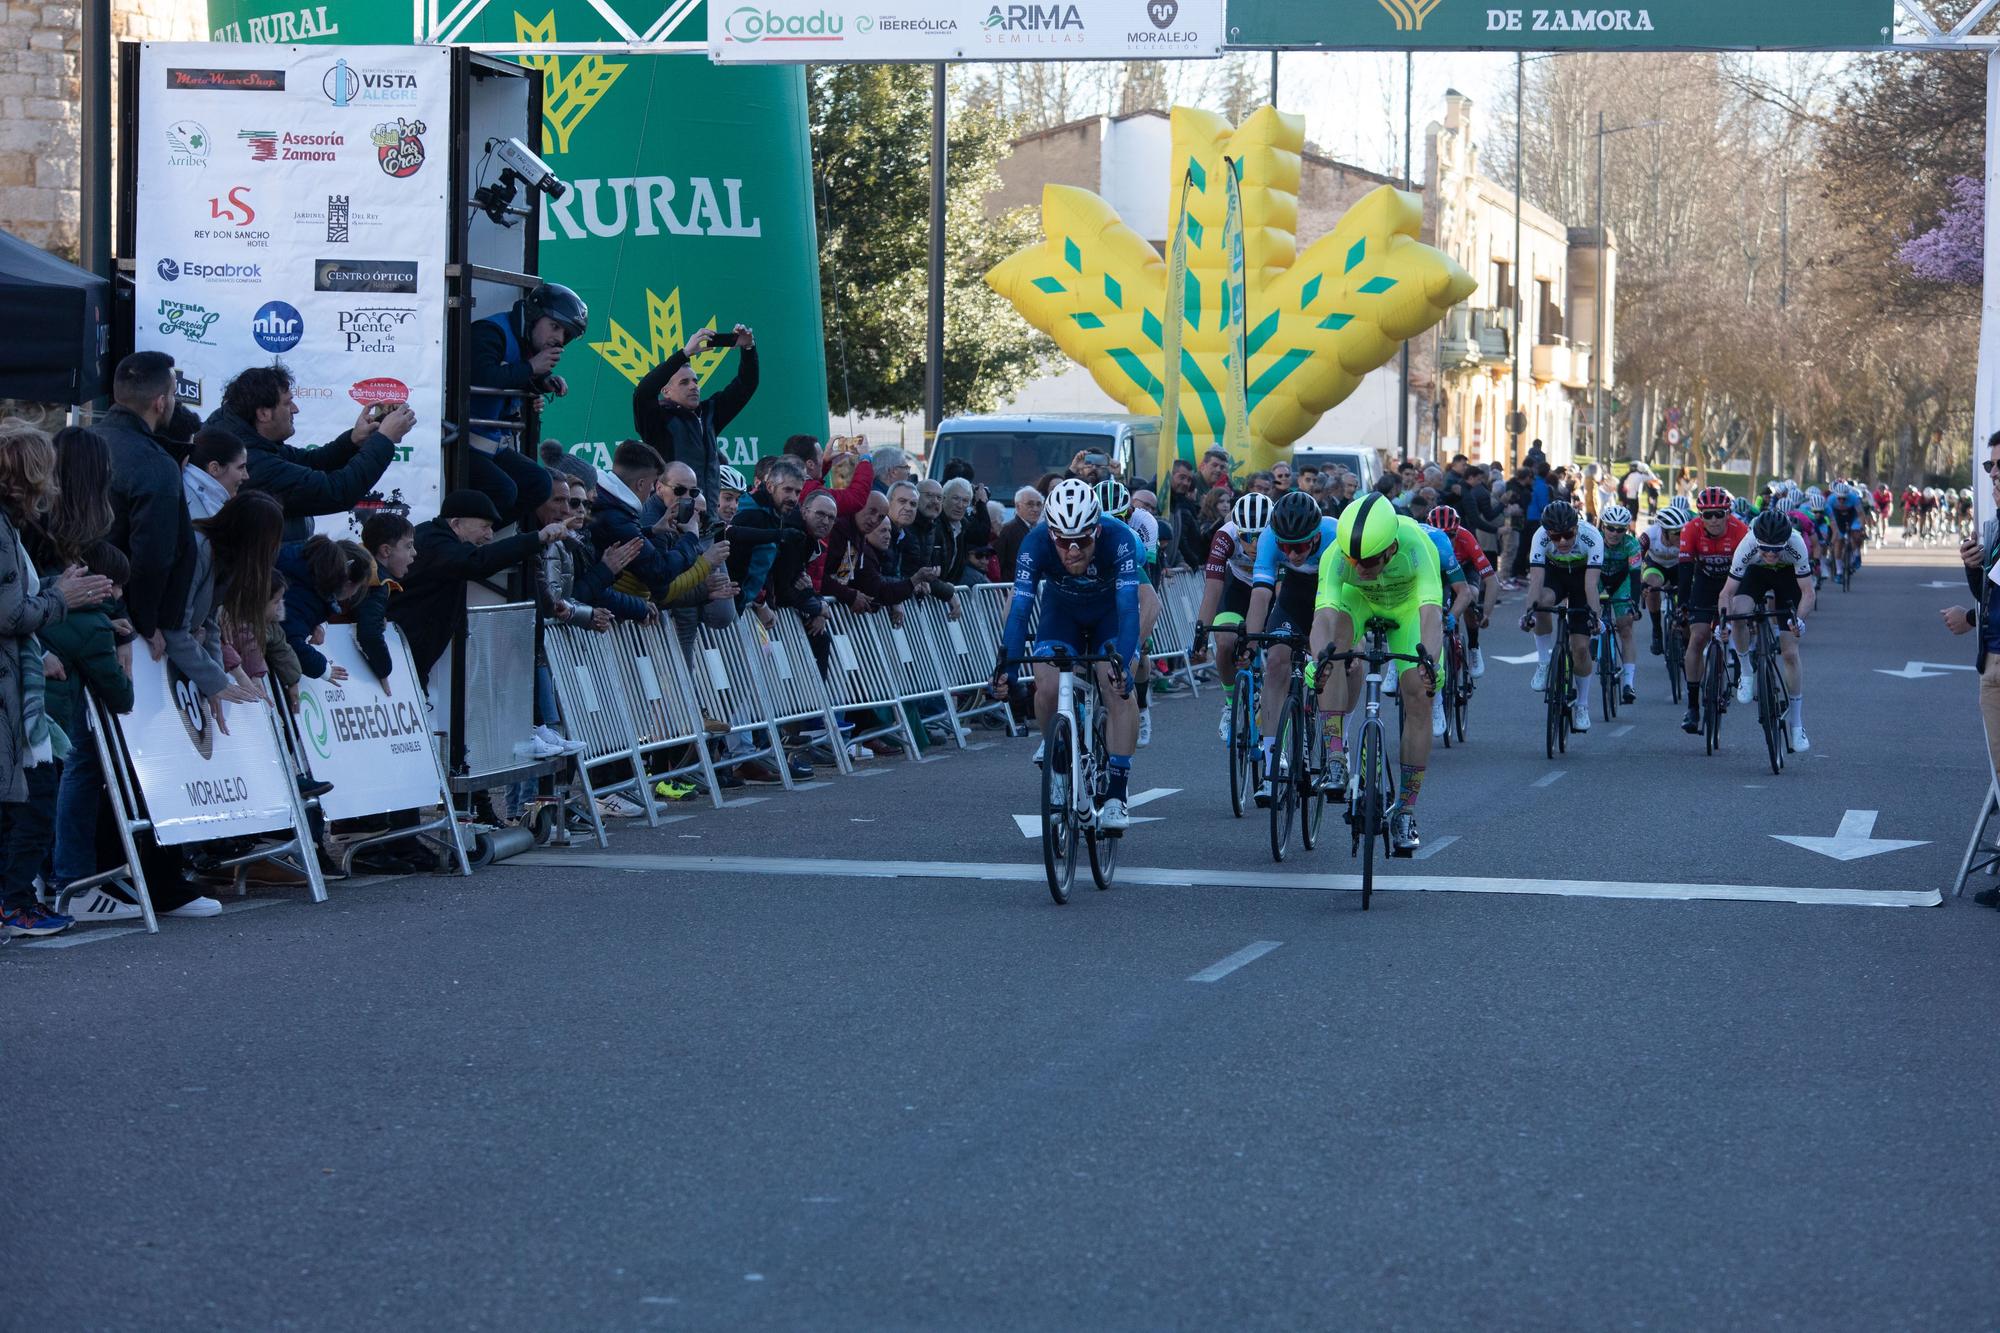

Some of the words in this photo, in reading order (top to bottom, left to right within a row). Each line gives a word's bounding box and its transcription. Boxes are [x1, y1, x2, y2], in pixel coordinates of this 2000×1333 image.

[248, 6, 339, 43] RURAL
[725, 6, 844, 43] Cobadu
[879, 18, 958, 30] IBEREÓLICA
[1486, 9, 1522, 31] DE
[1532, 9, 1655, 31] ZAMORA
[985, 33, 1085, 43] SEMILLAS
[1128, 31, 1198, 42] MORALEJO
[362, 74, 417, 89] VISTA
[362, 88, 417, 100] ALEGRE
[397, 117, 427, 139] bar
[282, 131, 345, 146] Asesoría
[282, 147, 337, 162] Zamora
[168, 156, 208, 169] Arribes
[539, 175, 761, 241] RURAL
[194, 231, 210, 239] REY
[213, 231, 232, 239] DON
[234, 231, 270, 240] SANCHO
[247, 240, 268, 248] HOTEL
[183, 261, 261, 278] Espabrok
[328, 271, 370, 281] CENTRO
[372, 270, 413, 282] ÓPTICO
[252, 310, 299, 334] mhr
[337, 311, 393, 333] Puente
[345, 332, 395, 353] Piedra
[385, 333, 395, 341] de
[175, 380, 200, 399] usi
[569, 441, 620, 471] CA
[325, 689, 346, 703] GRUPO
[330, 694, 423, 743] IBEREÓLICA
[390, 740, 422, 755] RENOVABLES
[186, 776, 248, 807] MORALEJO
